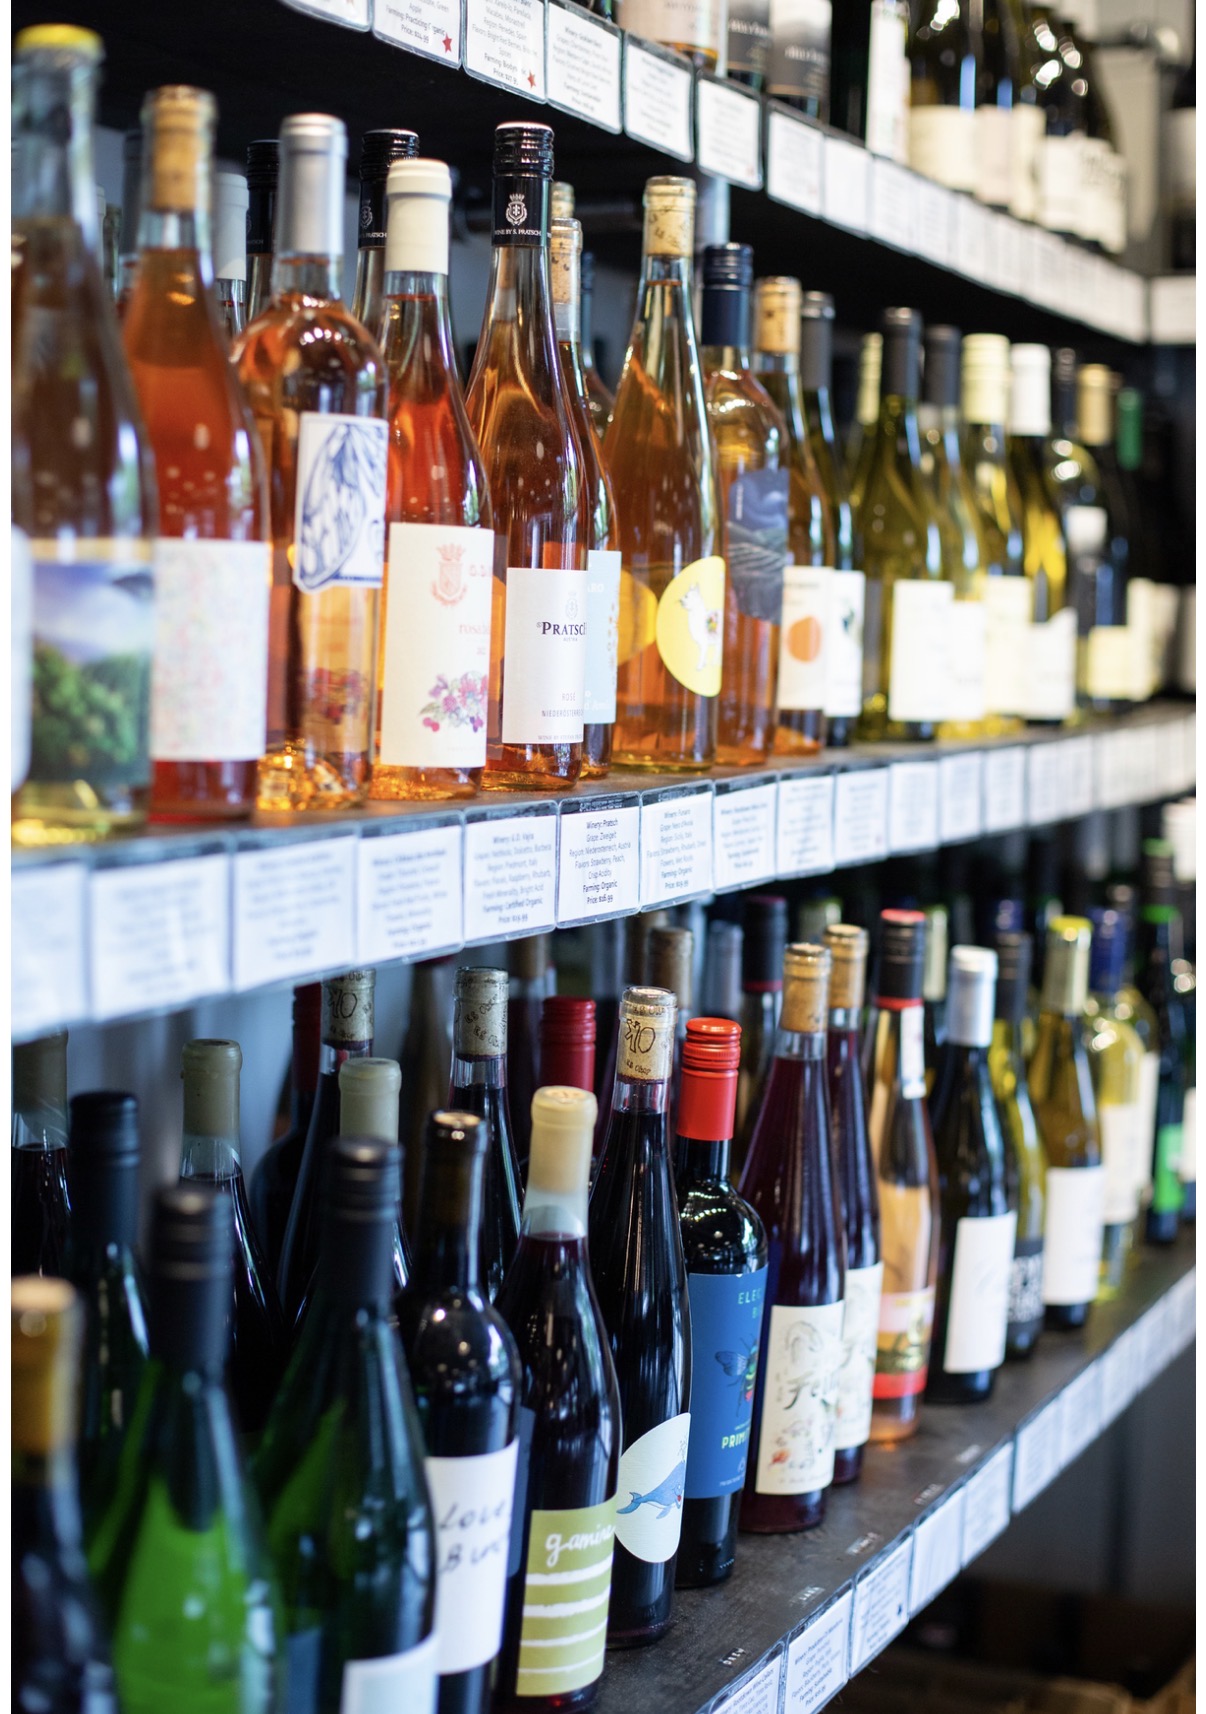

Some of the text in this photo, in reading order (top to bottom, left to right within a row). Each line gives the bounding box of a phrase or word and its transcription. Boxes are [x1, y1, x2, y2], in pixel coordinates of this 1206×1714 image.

[586, 822, 602, 830] Winery:
[582, 880, 618, 893] Farming: Organic
[587, 895, 598, 904] Price:
